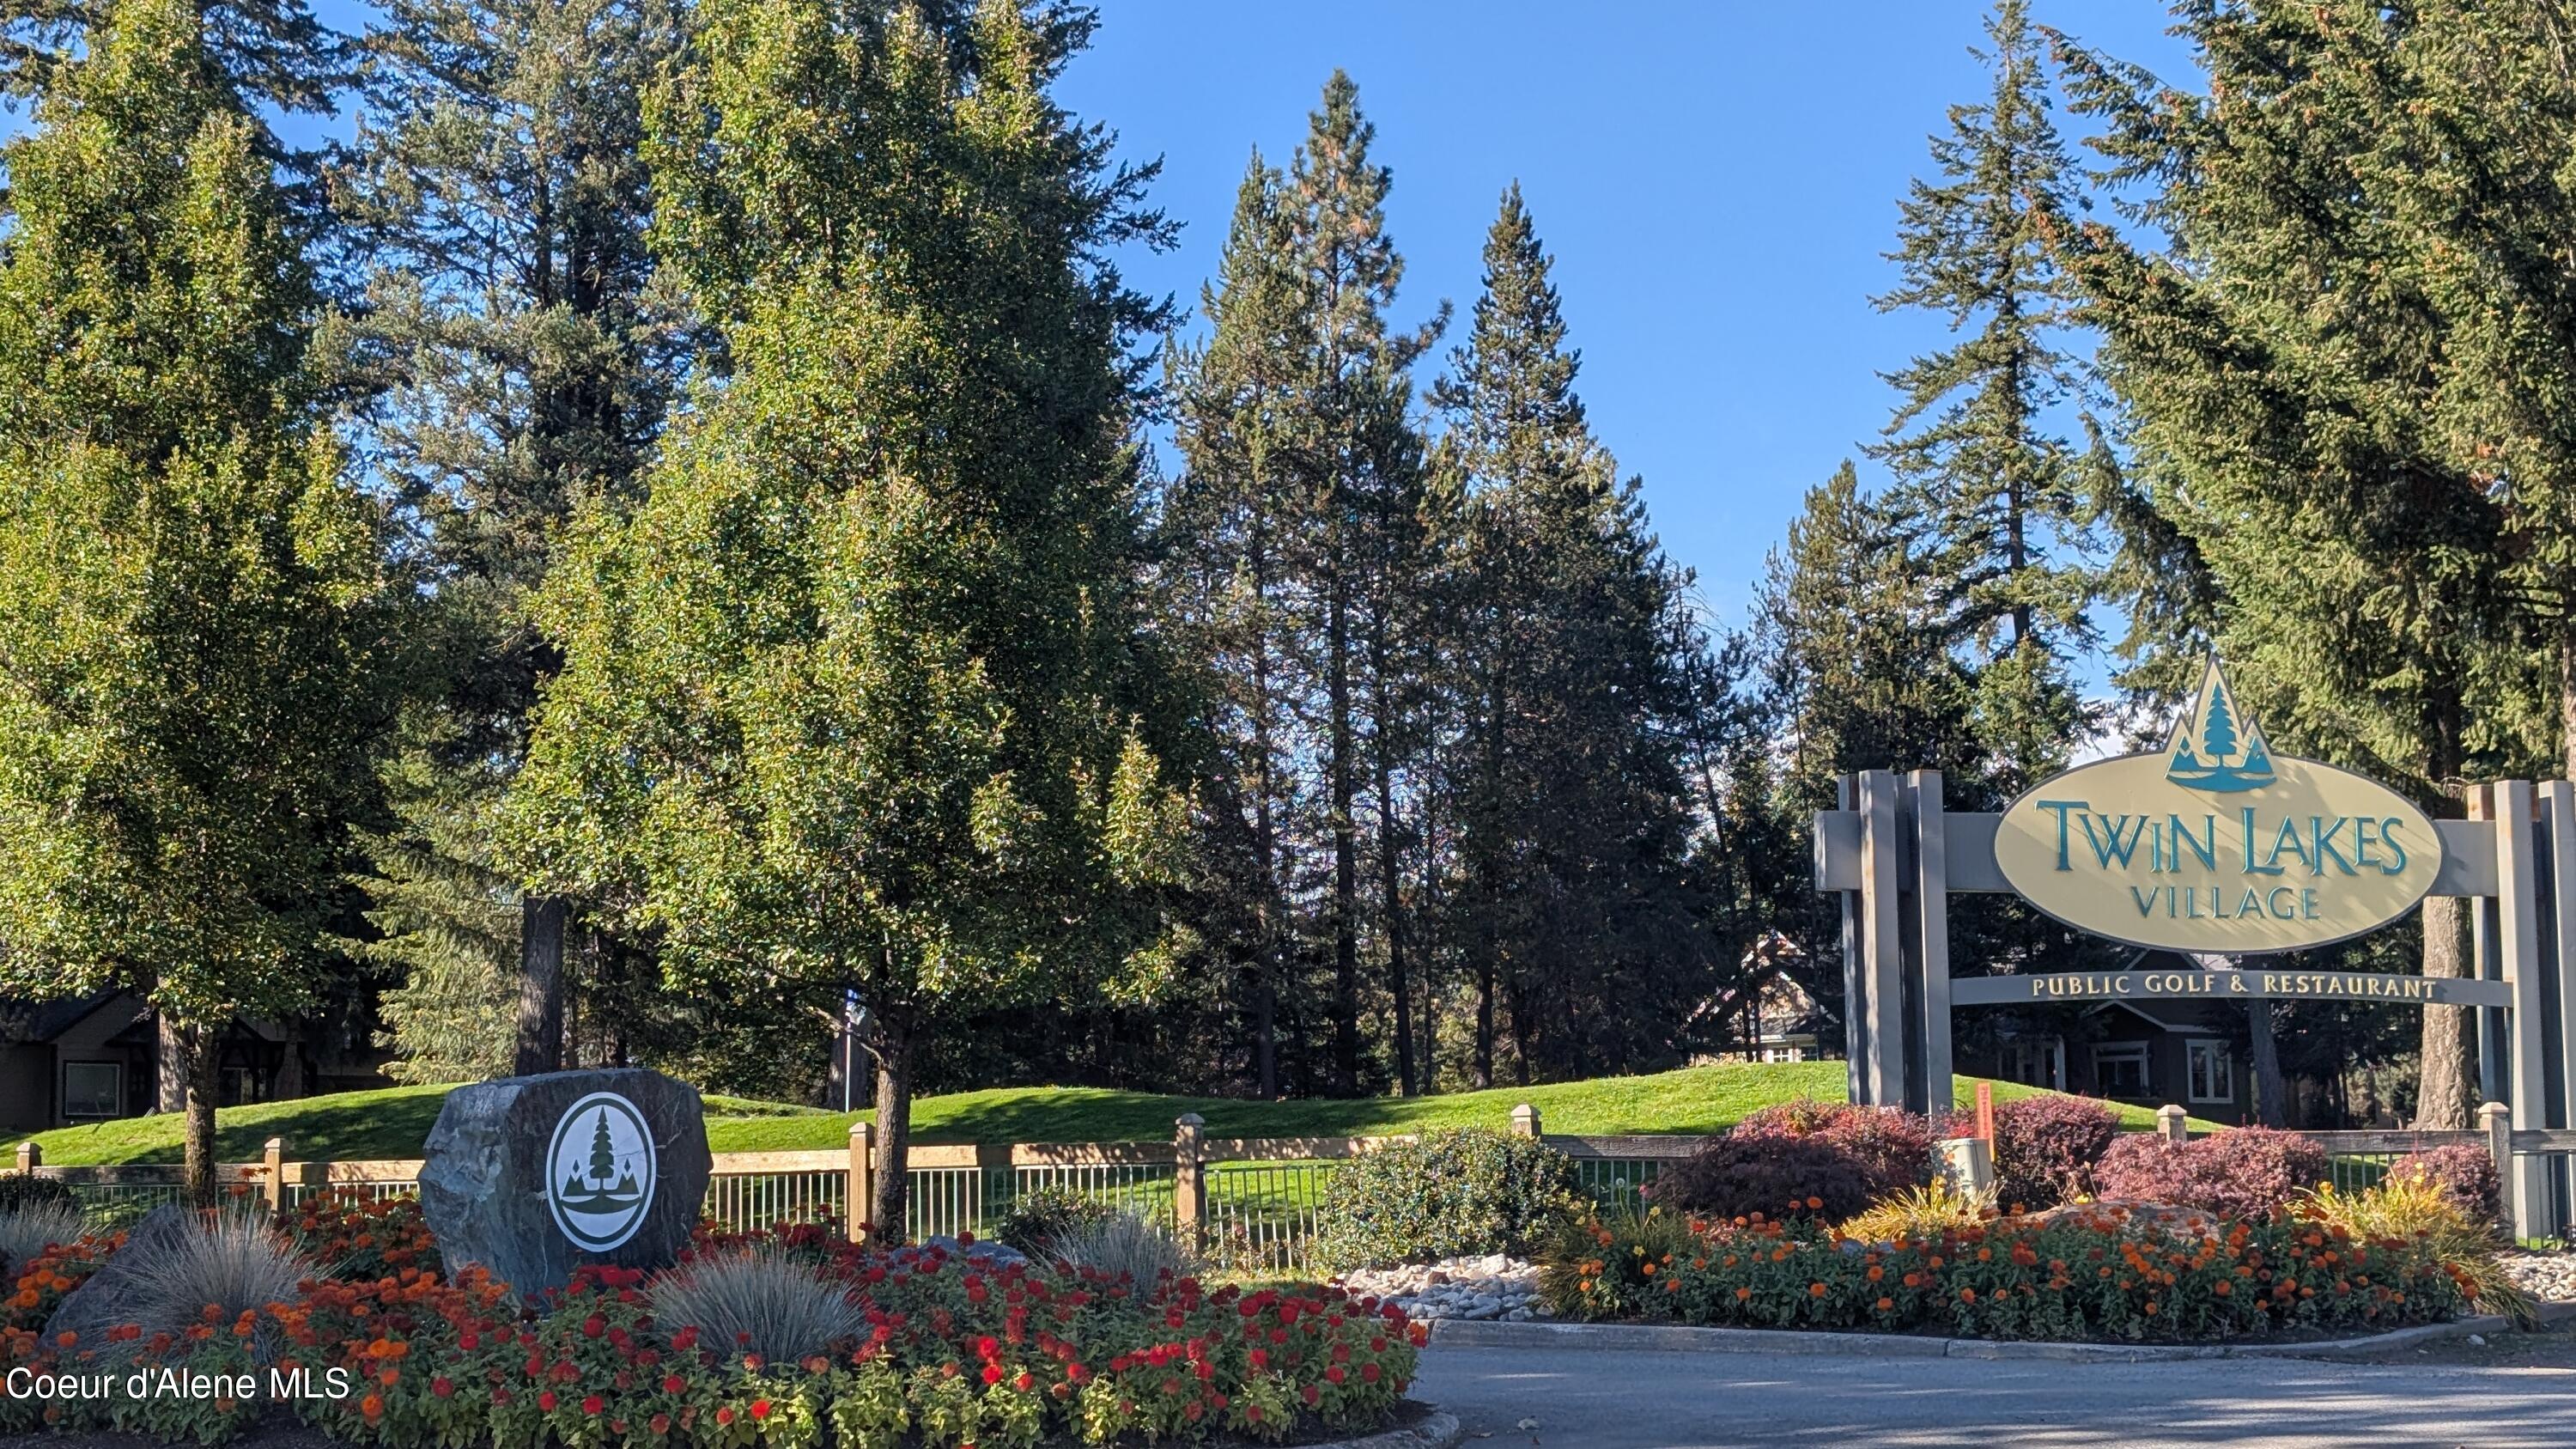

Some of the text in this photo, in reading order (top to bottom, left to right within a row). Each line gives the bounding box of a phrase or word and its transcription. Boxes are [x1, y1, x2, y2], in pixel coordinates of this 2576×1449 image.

[2034, 800, 2407, 877] TWIN LAKES
[2130, 886, 2321, 921] VILLAGE
[2032, 974, 2437, 999] PUBLIC GOLF & RESTAURANT
